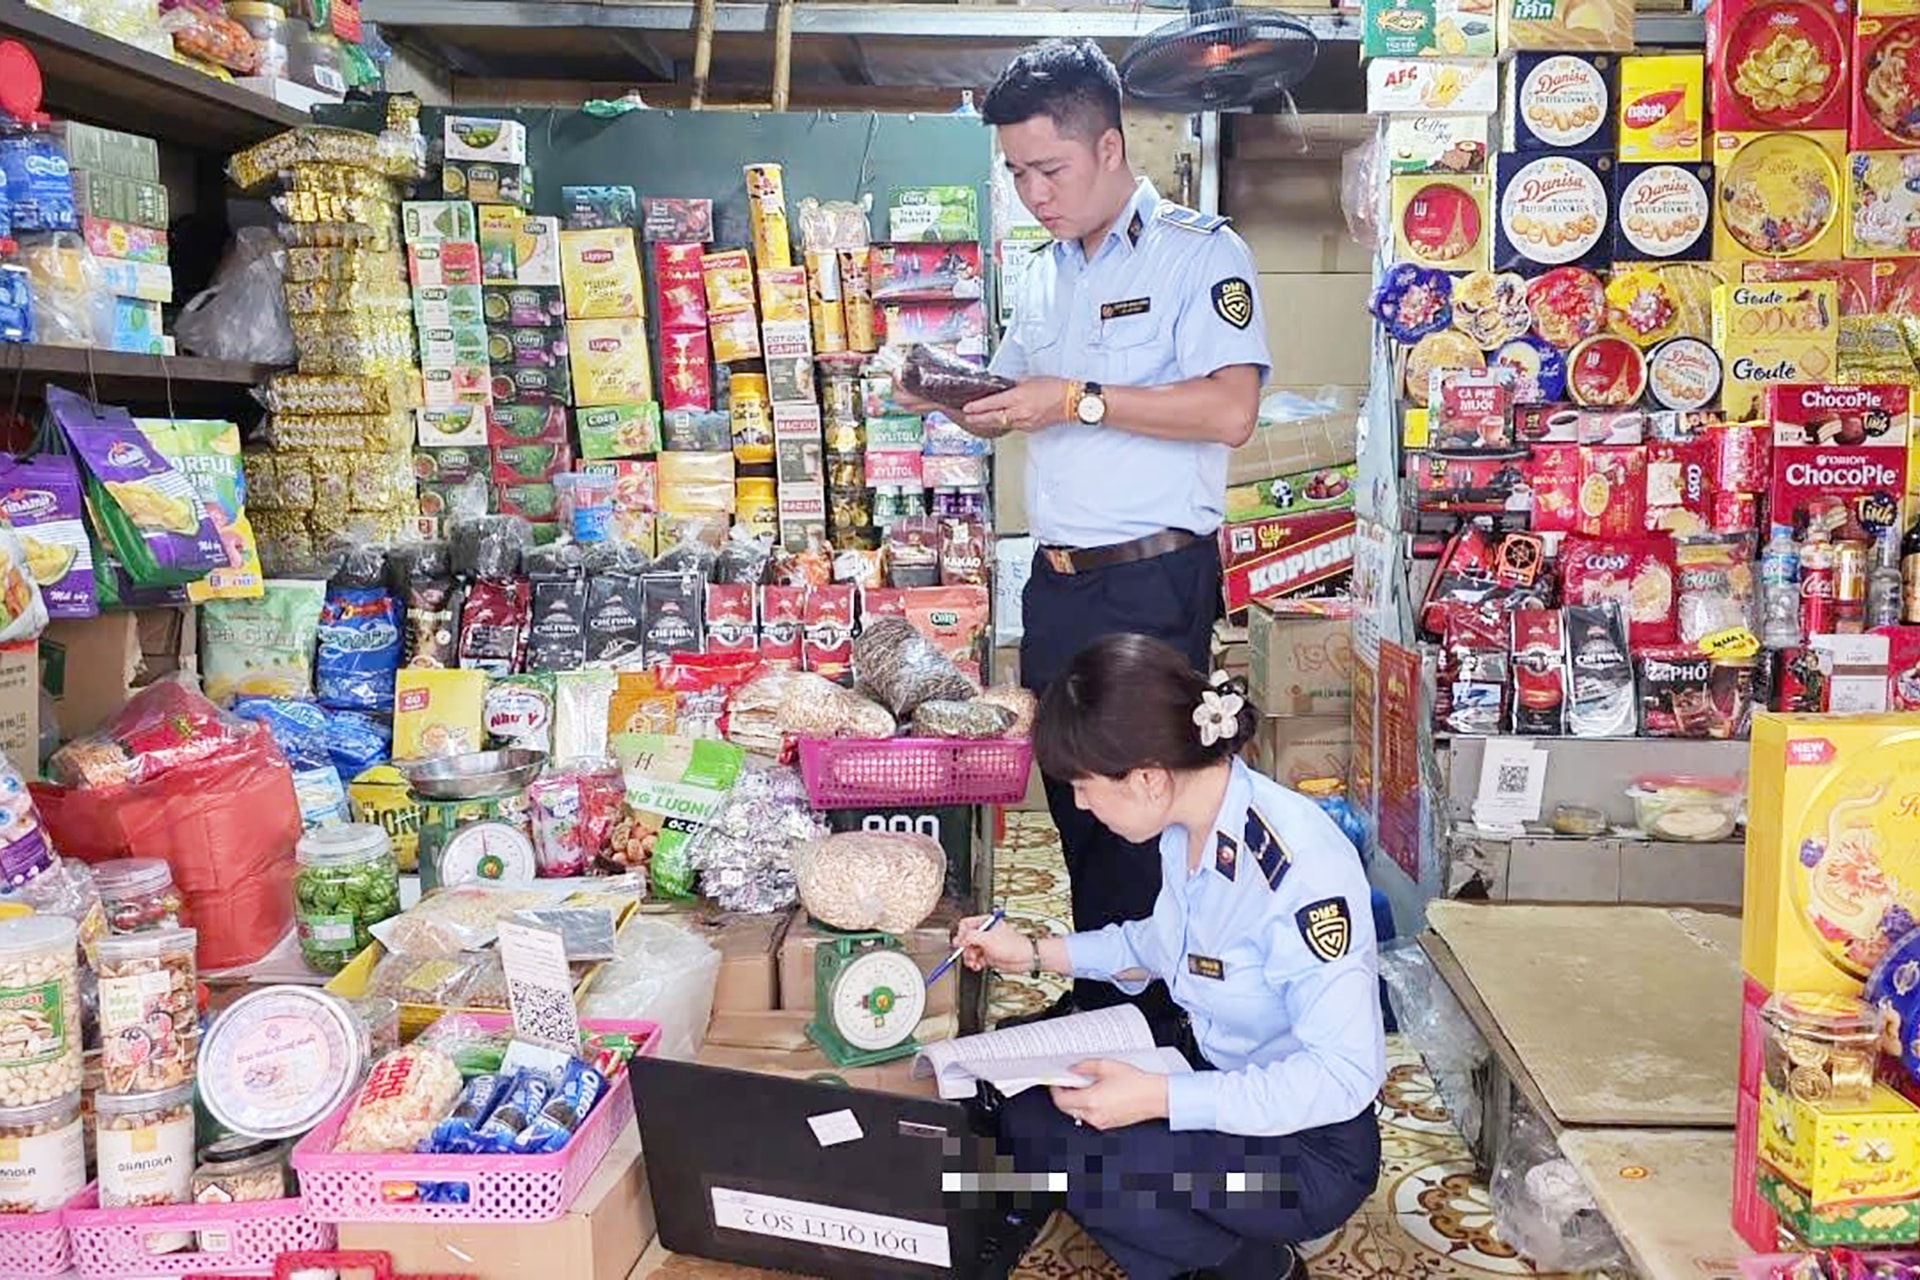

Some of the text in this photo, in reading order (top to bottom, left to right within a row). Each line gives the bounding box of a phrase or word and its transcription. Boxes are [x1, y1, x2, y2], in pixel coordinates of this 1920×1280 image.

[1385, 67, 1418, 88] AFC
[1534, 69, 1590, 96] Danisa
[1413, 116, 1449, 132] Coffee
[1516, 173, 1587, 204] Danisa
[1635, 179, 1691, 205] Danisa
[1801, 391, 1882, 409] ChocoPie
[1785, 464, 1897, 486] ChocoPie
[943, 556, 981, 568] KAKAO
[1584, 553, 1631, 571] COSY
[1791, 741, 1825, 753] NEW
[1309, 904, 1339, 923] DMS
[576, 1070, 600, 1119] OREO
[743, 1207, 755, 1225] 2
[803, 1218, 866, 1246] QLTT
